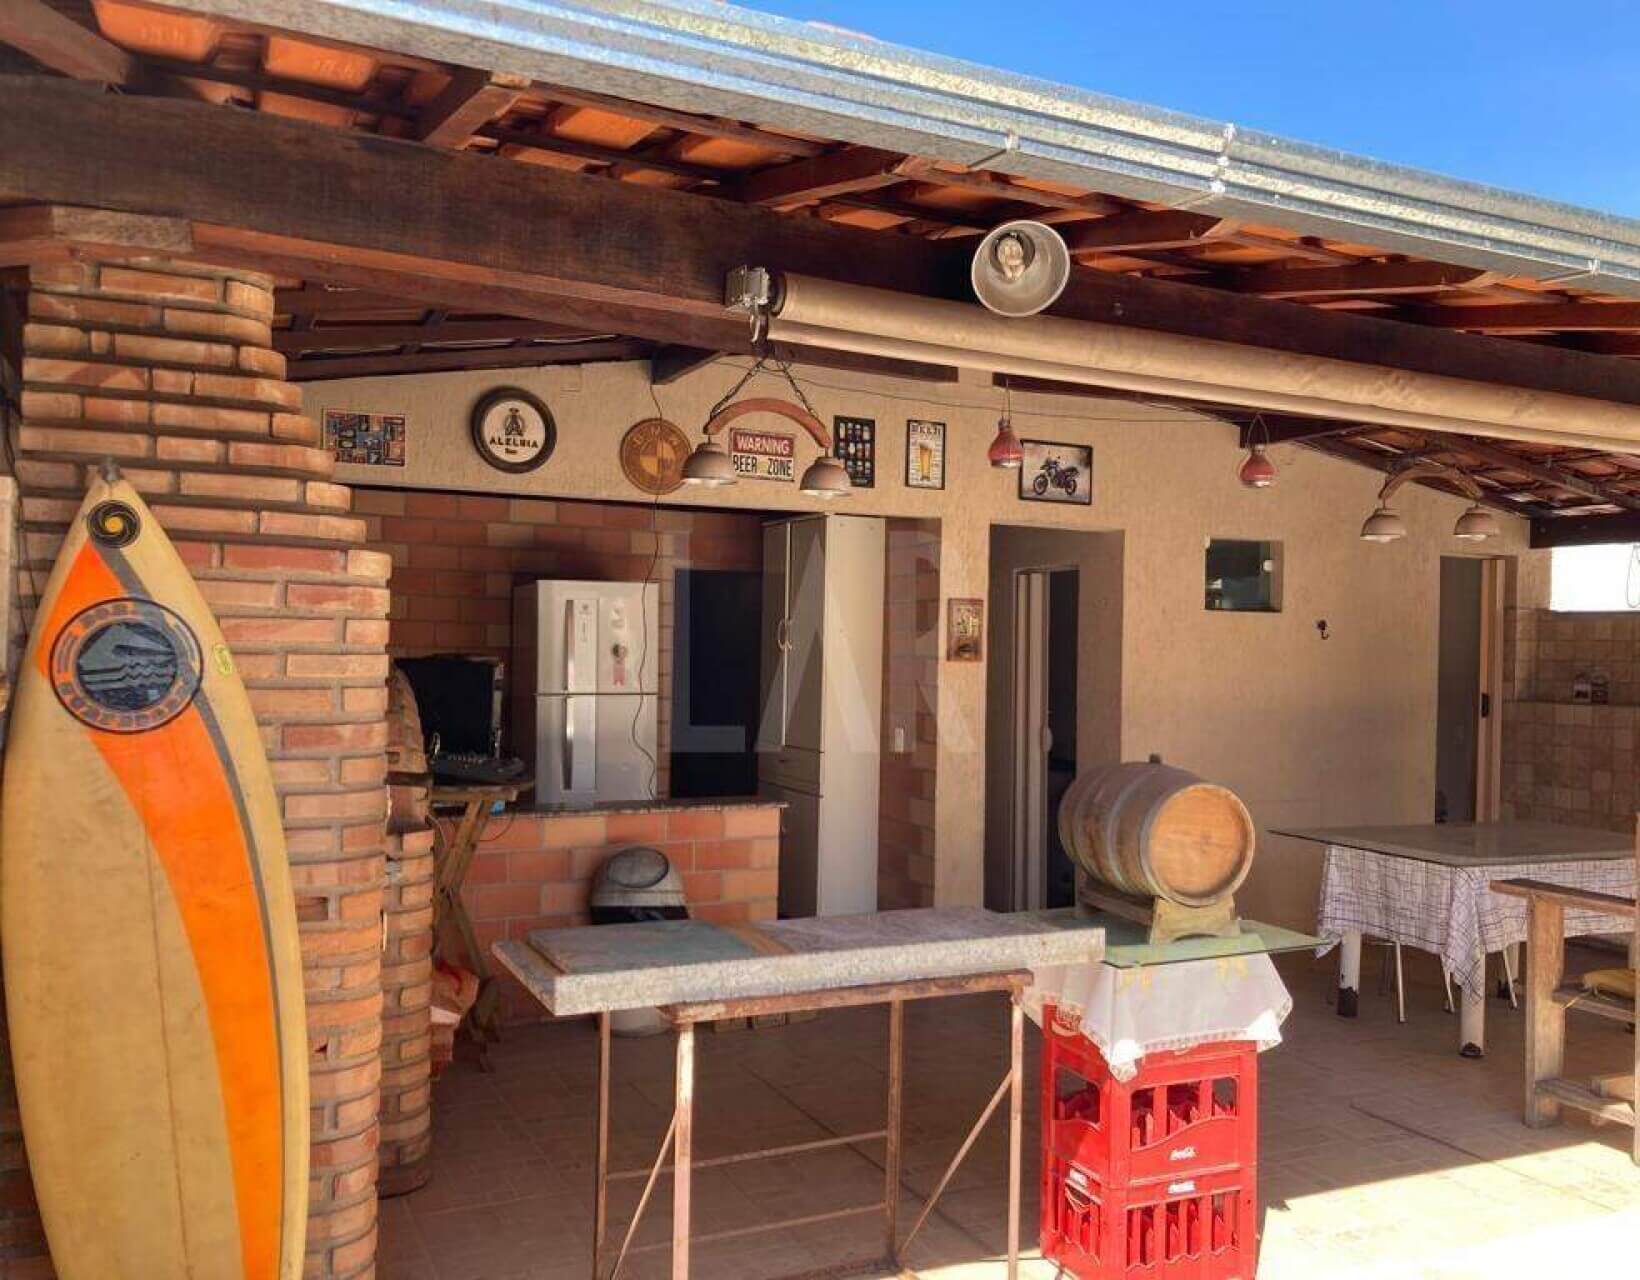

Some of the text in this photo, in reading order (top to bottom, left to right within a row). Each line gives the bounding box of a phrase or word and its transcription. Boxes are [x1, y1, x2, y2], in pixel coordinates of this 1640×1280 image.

[736, 434, 790, 454] WARNING
[733, 454, 793, 476] BEER ZONE
